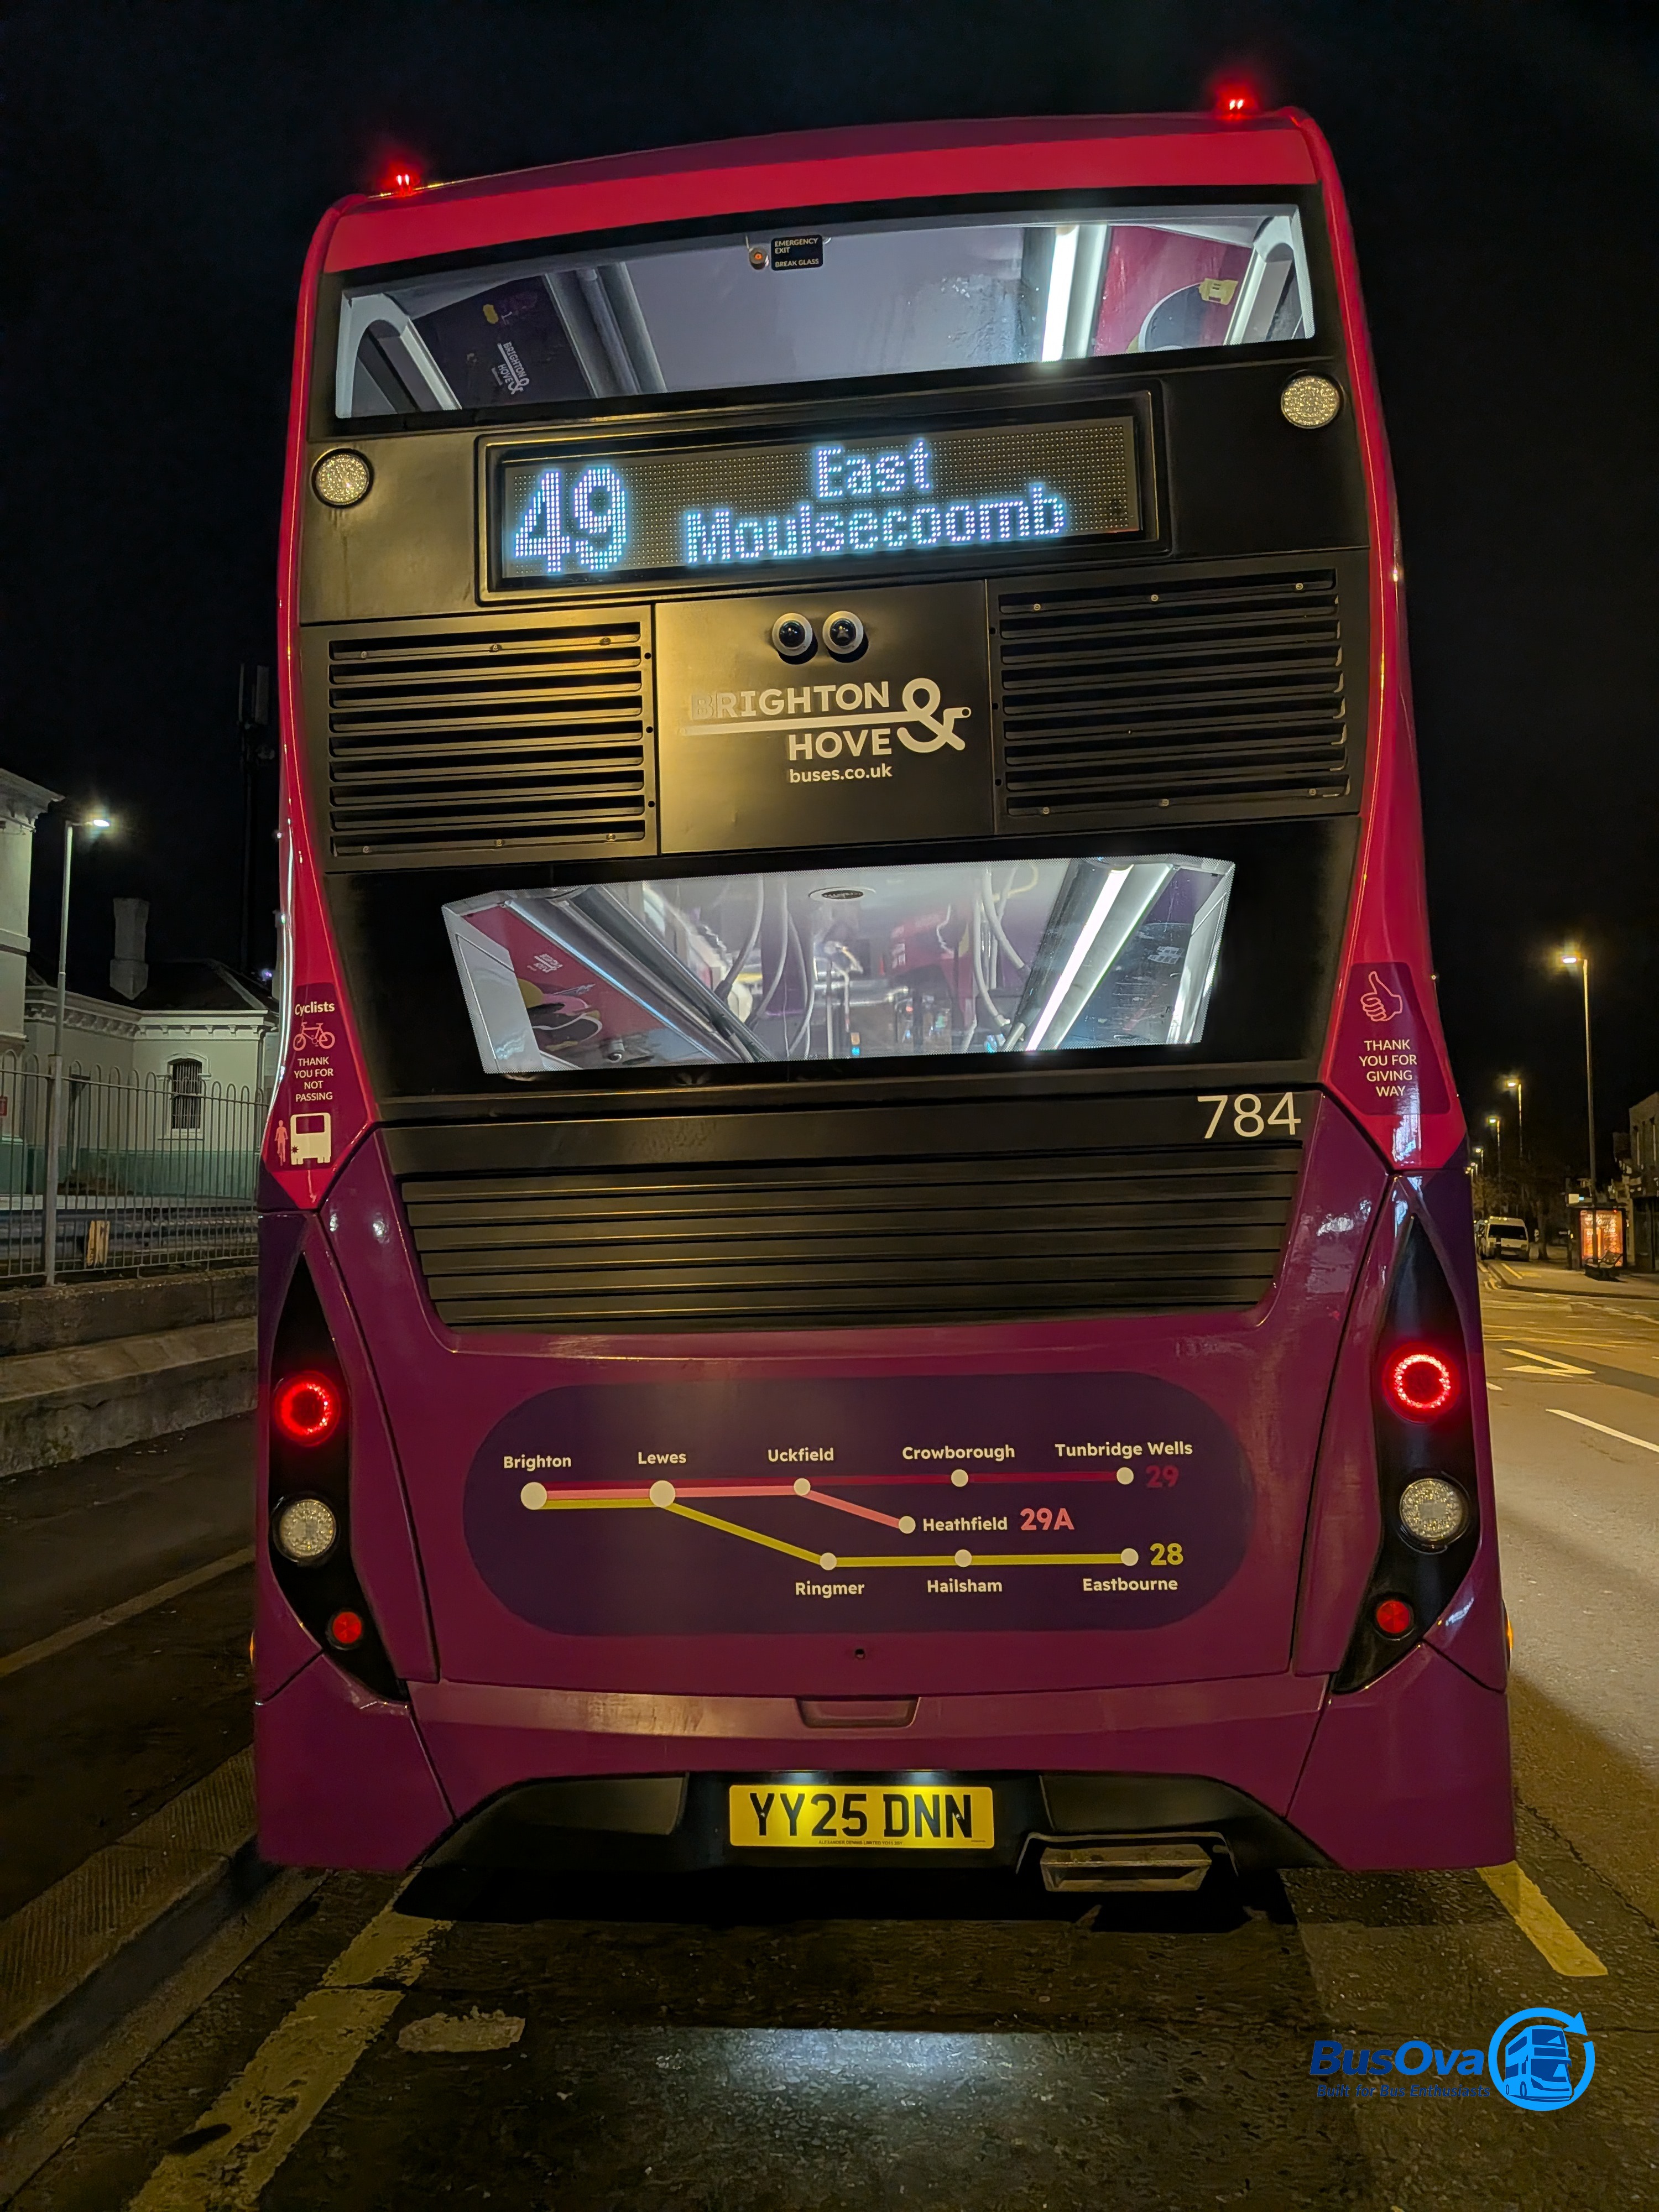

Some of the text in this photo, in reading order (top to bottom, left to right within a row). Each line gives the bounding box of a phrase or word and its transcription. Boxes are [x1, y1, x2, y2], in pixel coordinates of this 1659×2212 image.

[775, 238, 818, 247] EMERGENCY
[503, 342, 526, 377] BRIGHTON
[498, 363, 513, 384] HOVE
[817, 441, 932, 498] East
[515, 467, 627, 573] 49
[687, 486, 1065, 564] Moulsecoomb
[691, 681, 889, 719] BRIGHTON
[789, 728, 892, 761] HOVE
[790, 763, 893, 783] buses.co.uk
[295, 1001, 335, 1017] Cyclists
[1364, 1039, 1411, 1051] THANK
[298, 1056, 329, 1067] THANK
[1359, 1054, 1417, 1067] YOU FOR
[294, 1068, 334, 1078] YOU FOR
[1366, 1070, 1412, 1082] GIVING
[304, 1081, 324, 1090] NOT
[1375, 1086, 1406, 1097] WAY
[295, 1092, 333, 1102] PASSING
[1197, 1092, 1301, 1139] 784
[638, 1451, 687, 1465] Lewes
[768, 1447, 834, 1463] Uckfield
[902, 1444, 1015, 1462] Crowborough
[1055, 1441, 1193, 1459] Tunbridge Wells
[503, 1455, 572, 1472] Brighton
[1145, 1465, 1179, 1488] 29
[923, 1517, 1008, 1532] Heathfield
[1020, 1507, 1075, 1531] 29A
[1150, 1543, 1185, 1566] 28
[795, 1581, 865, 1599] Ringmer
[927, 1579, 1003, 1594] Hailsham
[1083, 1577, 1178, 1593] Eastbourne
[749, 1793, 972, 1838] YY25 DNN
